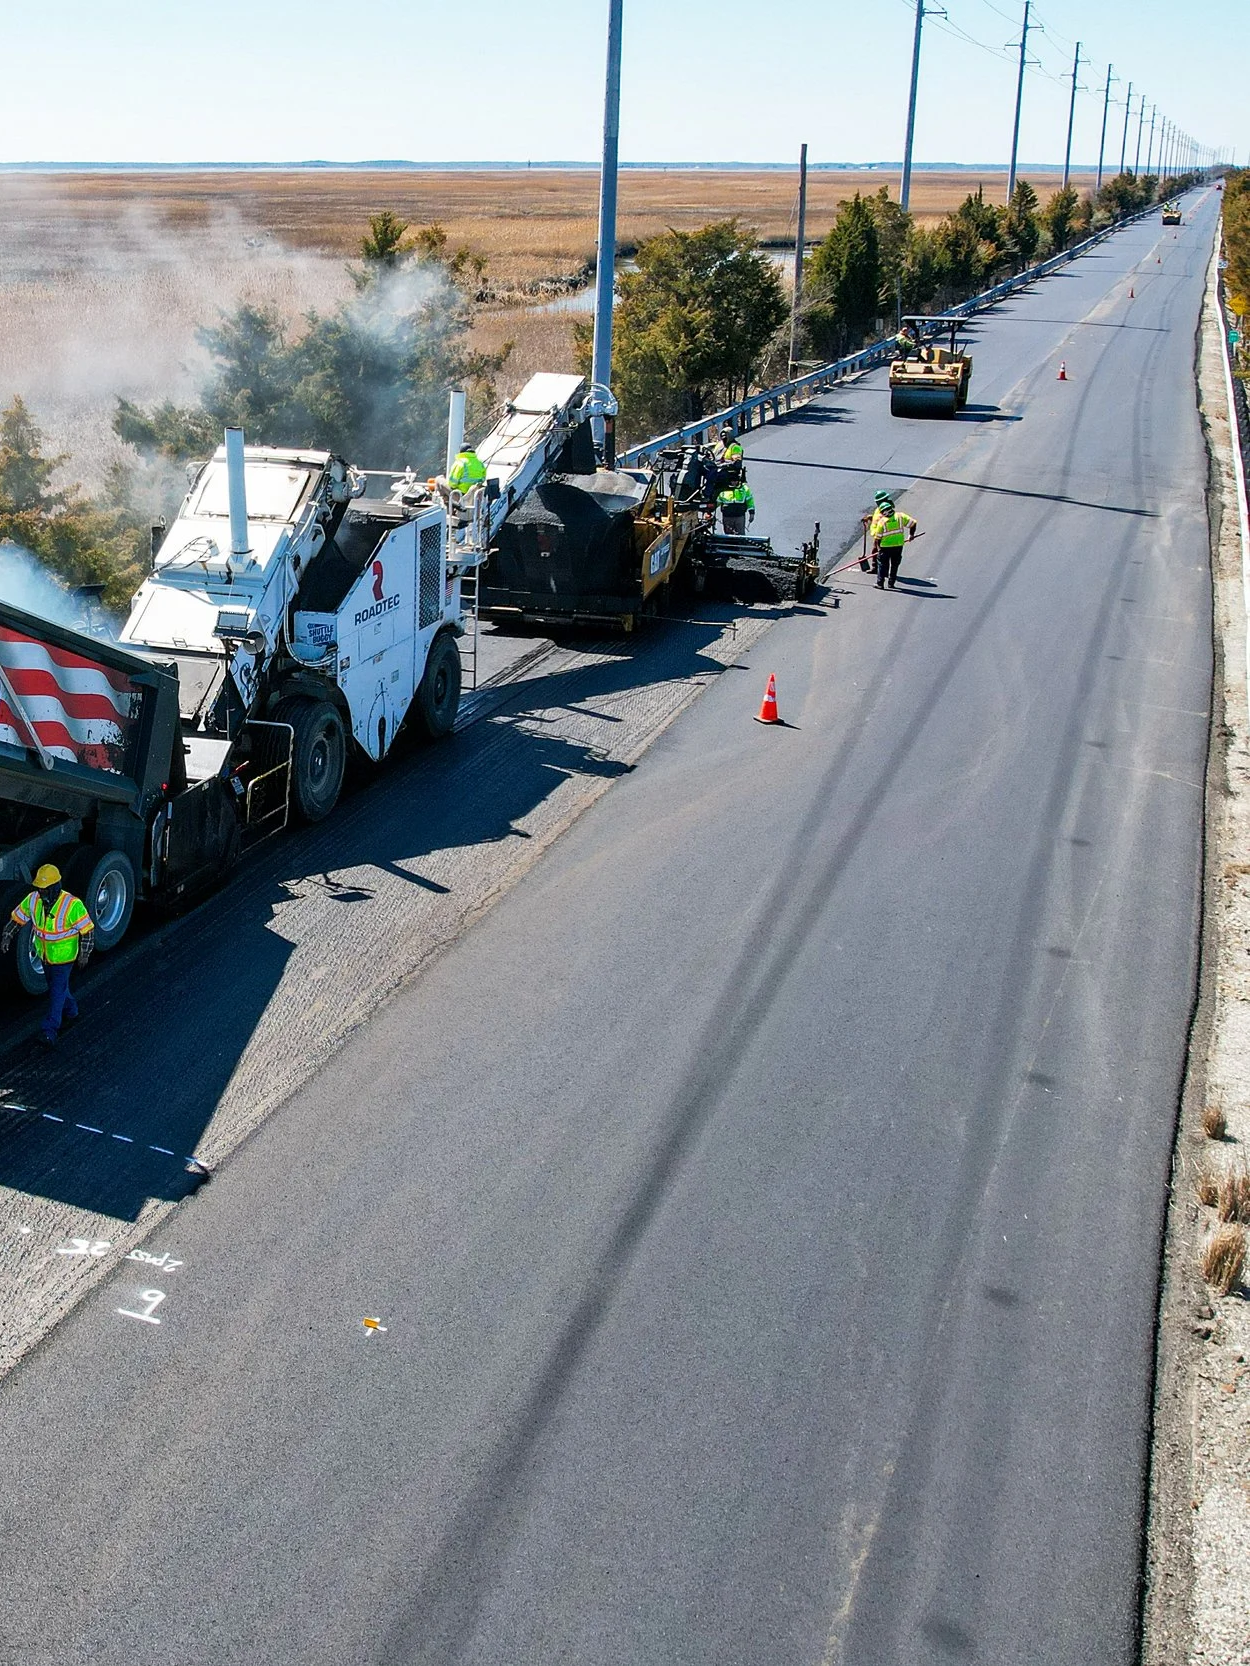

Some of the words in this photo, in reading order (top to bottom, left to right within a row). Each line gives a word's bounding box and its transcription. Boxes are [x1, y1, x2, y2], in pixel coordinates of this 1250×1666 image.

[354, 593, 401, 626] ROADTEC
[308, 624, 334, 638] SHUTTLE
[312, 632, 333, 644] BUGGY
